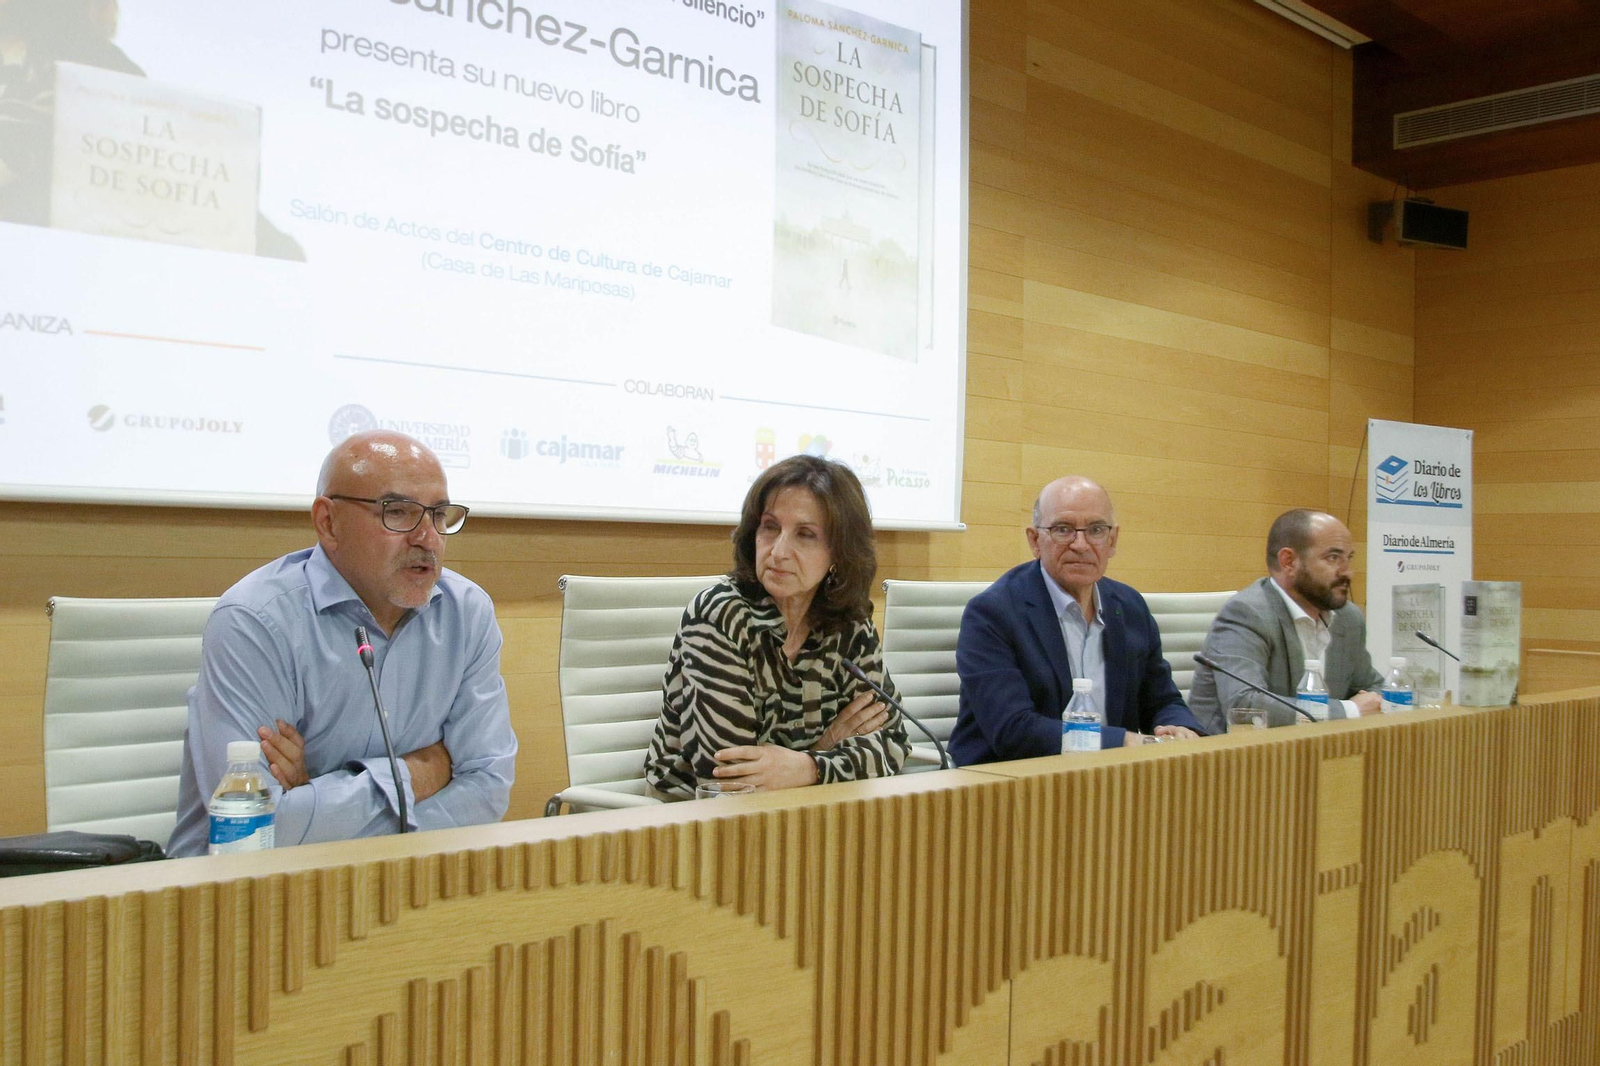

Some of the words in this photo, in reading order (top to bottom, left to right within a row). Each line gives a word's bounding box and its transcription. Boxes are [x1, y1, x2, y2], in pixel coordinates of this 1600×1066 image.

[787, 9, 825, 27] PALOMA
[389, 0, 762, 103] nchez-Garnica
[837, 41, 862, 69] LA
[321, 28, 456, 79] presenta
[463, 62, 495, 88] su
[503, 73, 584, 109] nuevo
[591, 89, 641, 123] libro
[793, 61, 903, 114] SOSPECHA
[142, 114, 177, 141] LA
[310, 76, 365, 116] “La
[374, 96, 520, 149] sospecha
[528, 128, 562, 157] de
[800, 94, 827, 123] DE
[834, 105, 897, 144] SOFÍA
[81, 133, 231, 182] SOSPECHA
[89, 164, 125, 191] DE
[136, 172, 221, 210] SOFÍA
[290, 198, 348, 226] Salón
[353, 212, 381, 231] de
[384, 216, 442, 241] Actos
[446, 228, 475, 247] del
[479, 232, 543, 258] Centro
[548, 245, 571, 262] de
[576, 248, 637, 274] Cultura
[642, 262, 663, 278] de
[667, 264, 733, 289] Cajamar
[421, 251, 476, 275] (Casa
[481, 262, 505, 279] de
[508, 264, 540, 285] Las
[544, 270, 636, 302] Mariposas)
[0, 312, 73, 336] ANIZA
[623, 379, 714, 401] COLABORAN
[123, 412, 246, 435] GRUPOJOLY
[536, 434, 625, 464] cajamar
[652, 463, 721, 478] MICHELIN
[886, 467, 931, 489] Picasso
[1414, 459, 1447, 477] Diario
[1449, 463, 1461, 478] de
[1413, 481, 1428, 498] los
[1430, 480, 1462, 504] Libros
[1383, 534, 1409, 547] Diario
[1409, 535, 1420, 548] de
[1420, 535, 1455, 549] Almería
